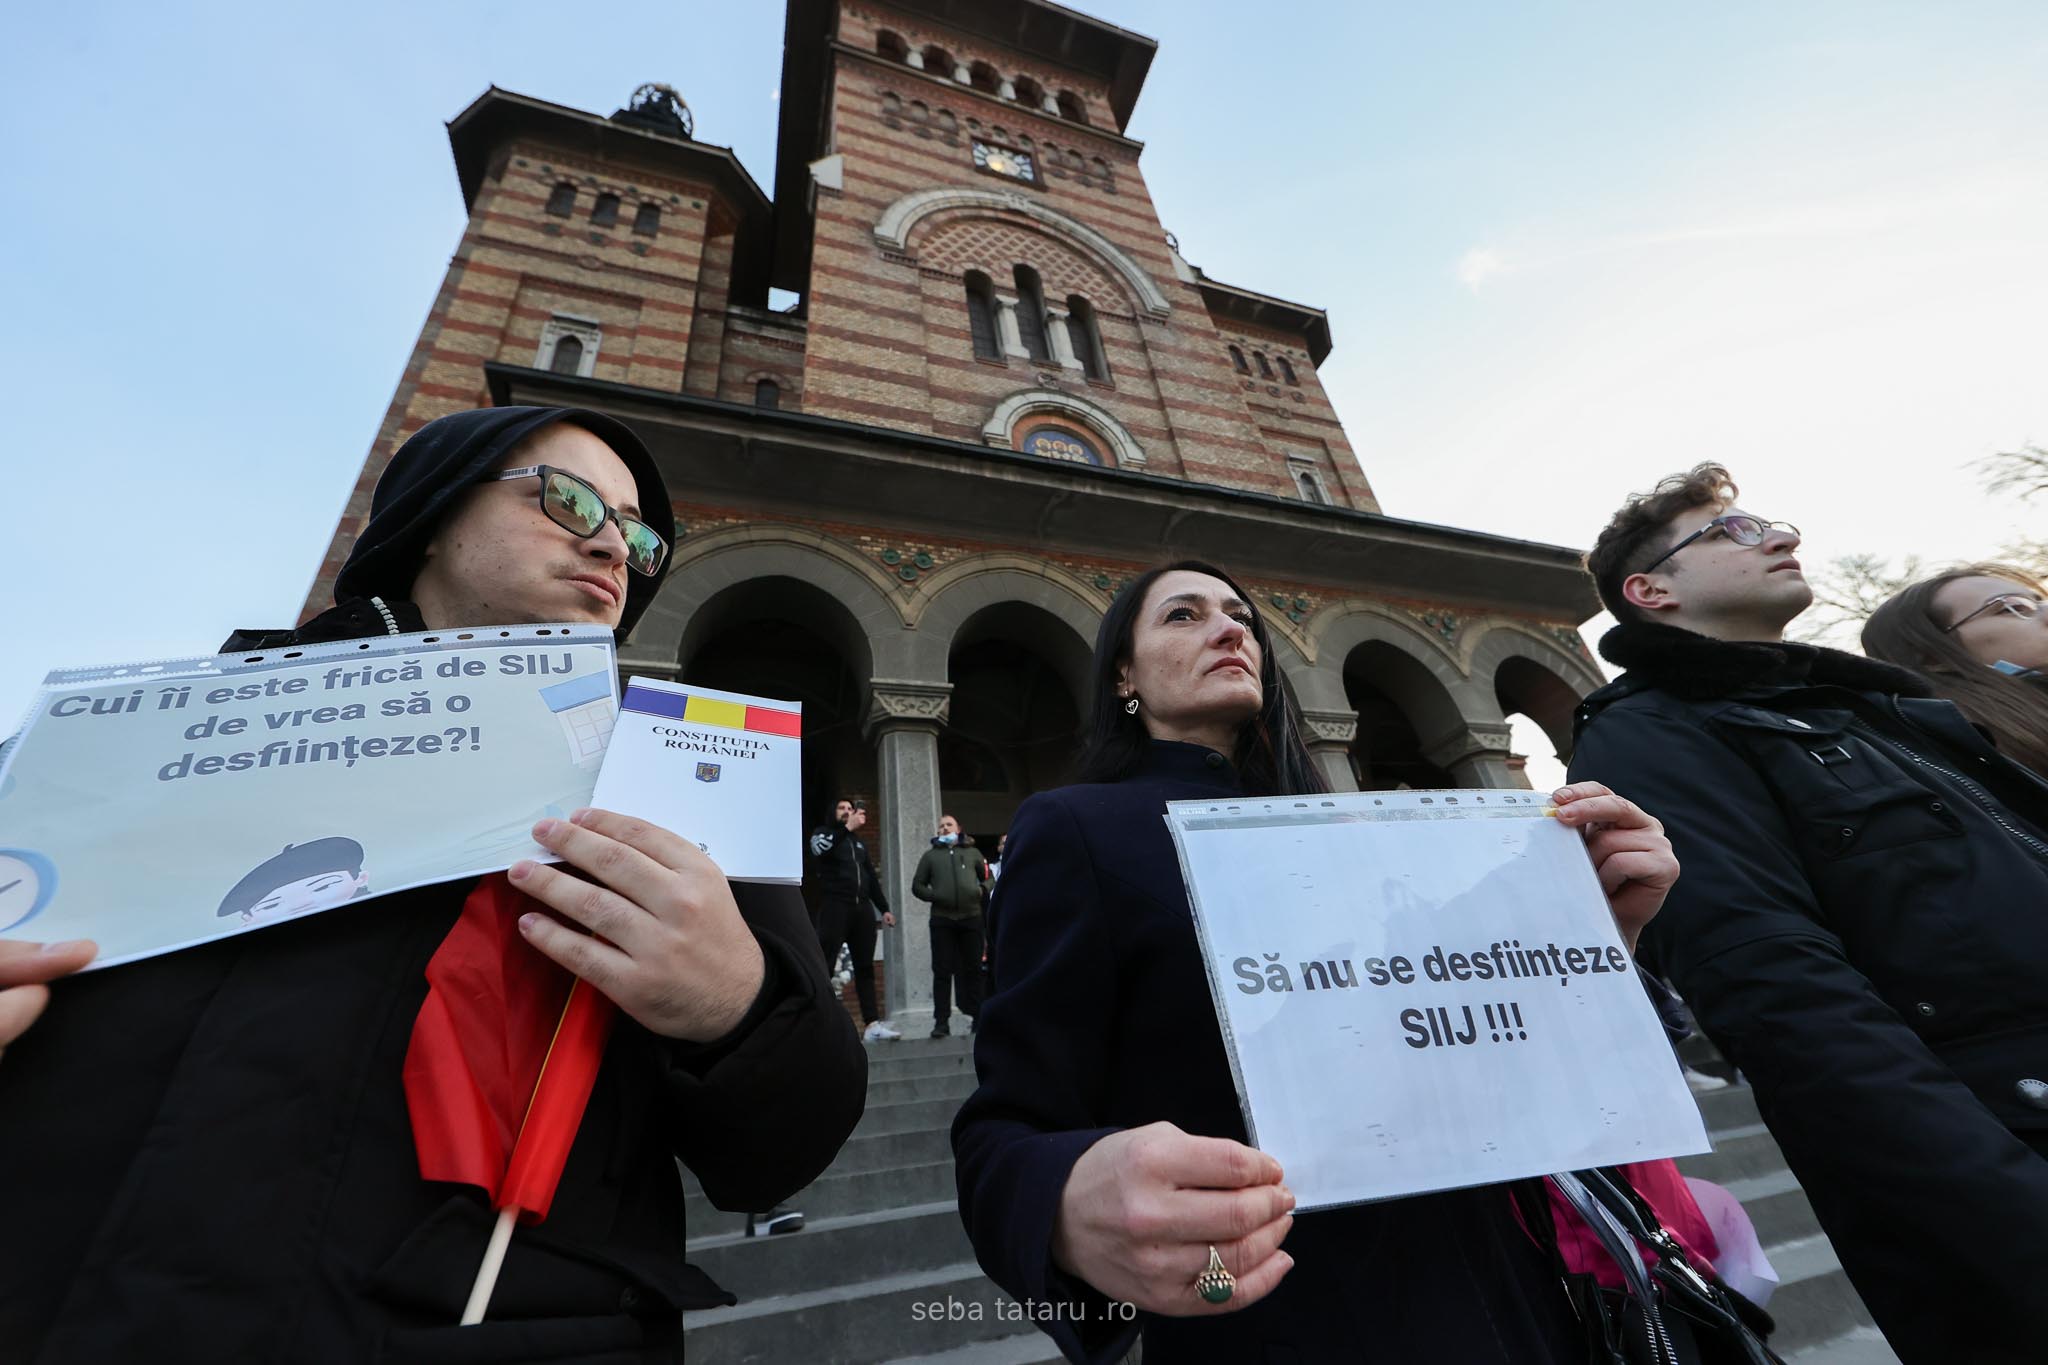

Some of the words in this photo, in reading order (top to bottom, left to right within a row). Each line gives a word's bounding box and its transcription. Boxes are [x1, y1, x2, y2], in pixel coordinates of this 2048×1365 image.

[49, 689, 145, 717] Cui
[157, 686, 193, 709] îi
[205, 676, 309, 704] este
[323, 659, 423, 690] frică
[436, 656, 487, 678] de
[499, 653, 574, 675] SIIJ
[184, 715, 248, 740] de
[264, 703, 366, 730] vrea
[380, 690, 431, 717] să
[445, 694, 472, 713] o
[652, 726, 771, 751] CONSTITUȚIA
[157, 726, 481, 782] desființeze?!
[665, 739, 757, 760] ROMÂNIEI
[1233, 952, 1294, 995] Să
[1300, 960, 1359, 991] nu
[1364, 955, 1416, 986] se
[1422, 939, 1628, 987] desființeze
[1400, 1005, 1477, 1049] SIIJ
[1483, 1002, 1528, 1043] !!!
